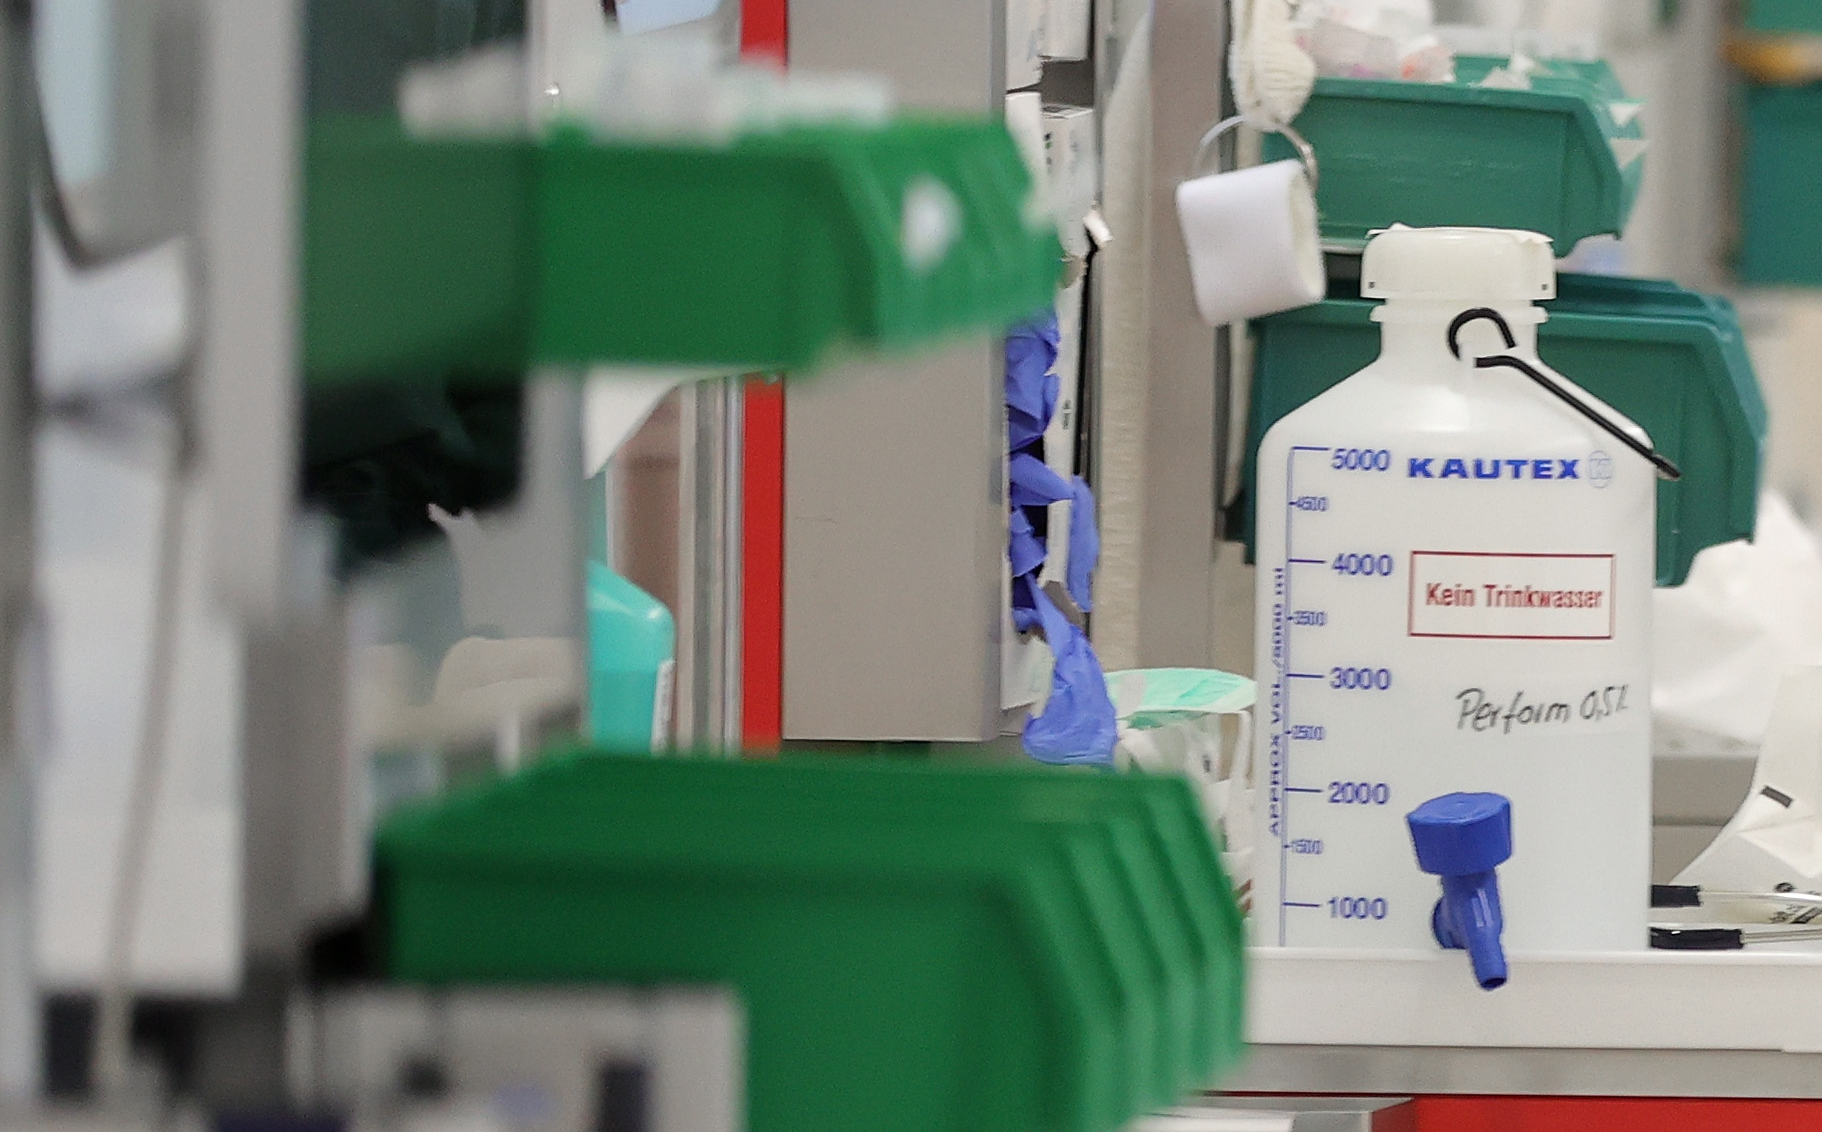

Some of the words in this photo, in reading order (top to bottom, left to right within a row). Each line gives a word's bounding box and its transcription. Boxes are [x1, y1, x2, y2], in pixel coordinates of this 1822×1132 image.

[1331, 447, 1391, 471] 5000
[1407, 458, 1581, 479] KAUTEX
[1331, 553, 1393, 576] 4000
[1426, 582, 1476, 607] Kein
[1482, 584, 1603, 608] Trinkwasser
[1330, 667, 1392, 691] 3000
[1456, 688, 1571, 735] Perform
[1328, 780, 1391, 805] 2000
[1327, 896, 1388, 920] 1000
